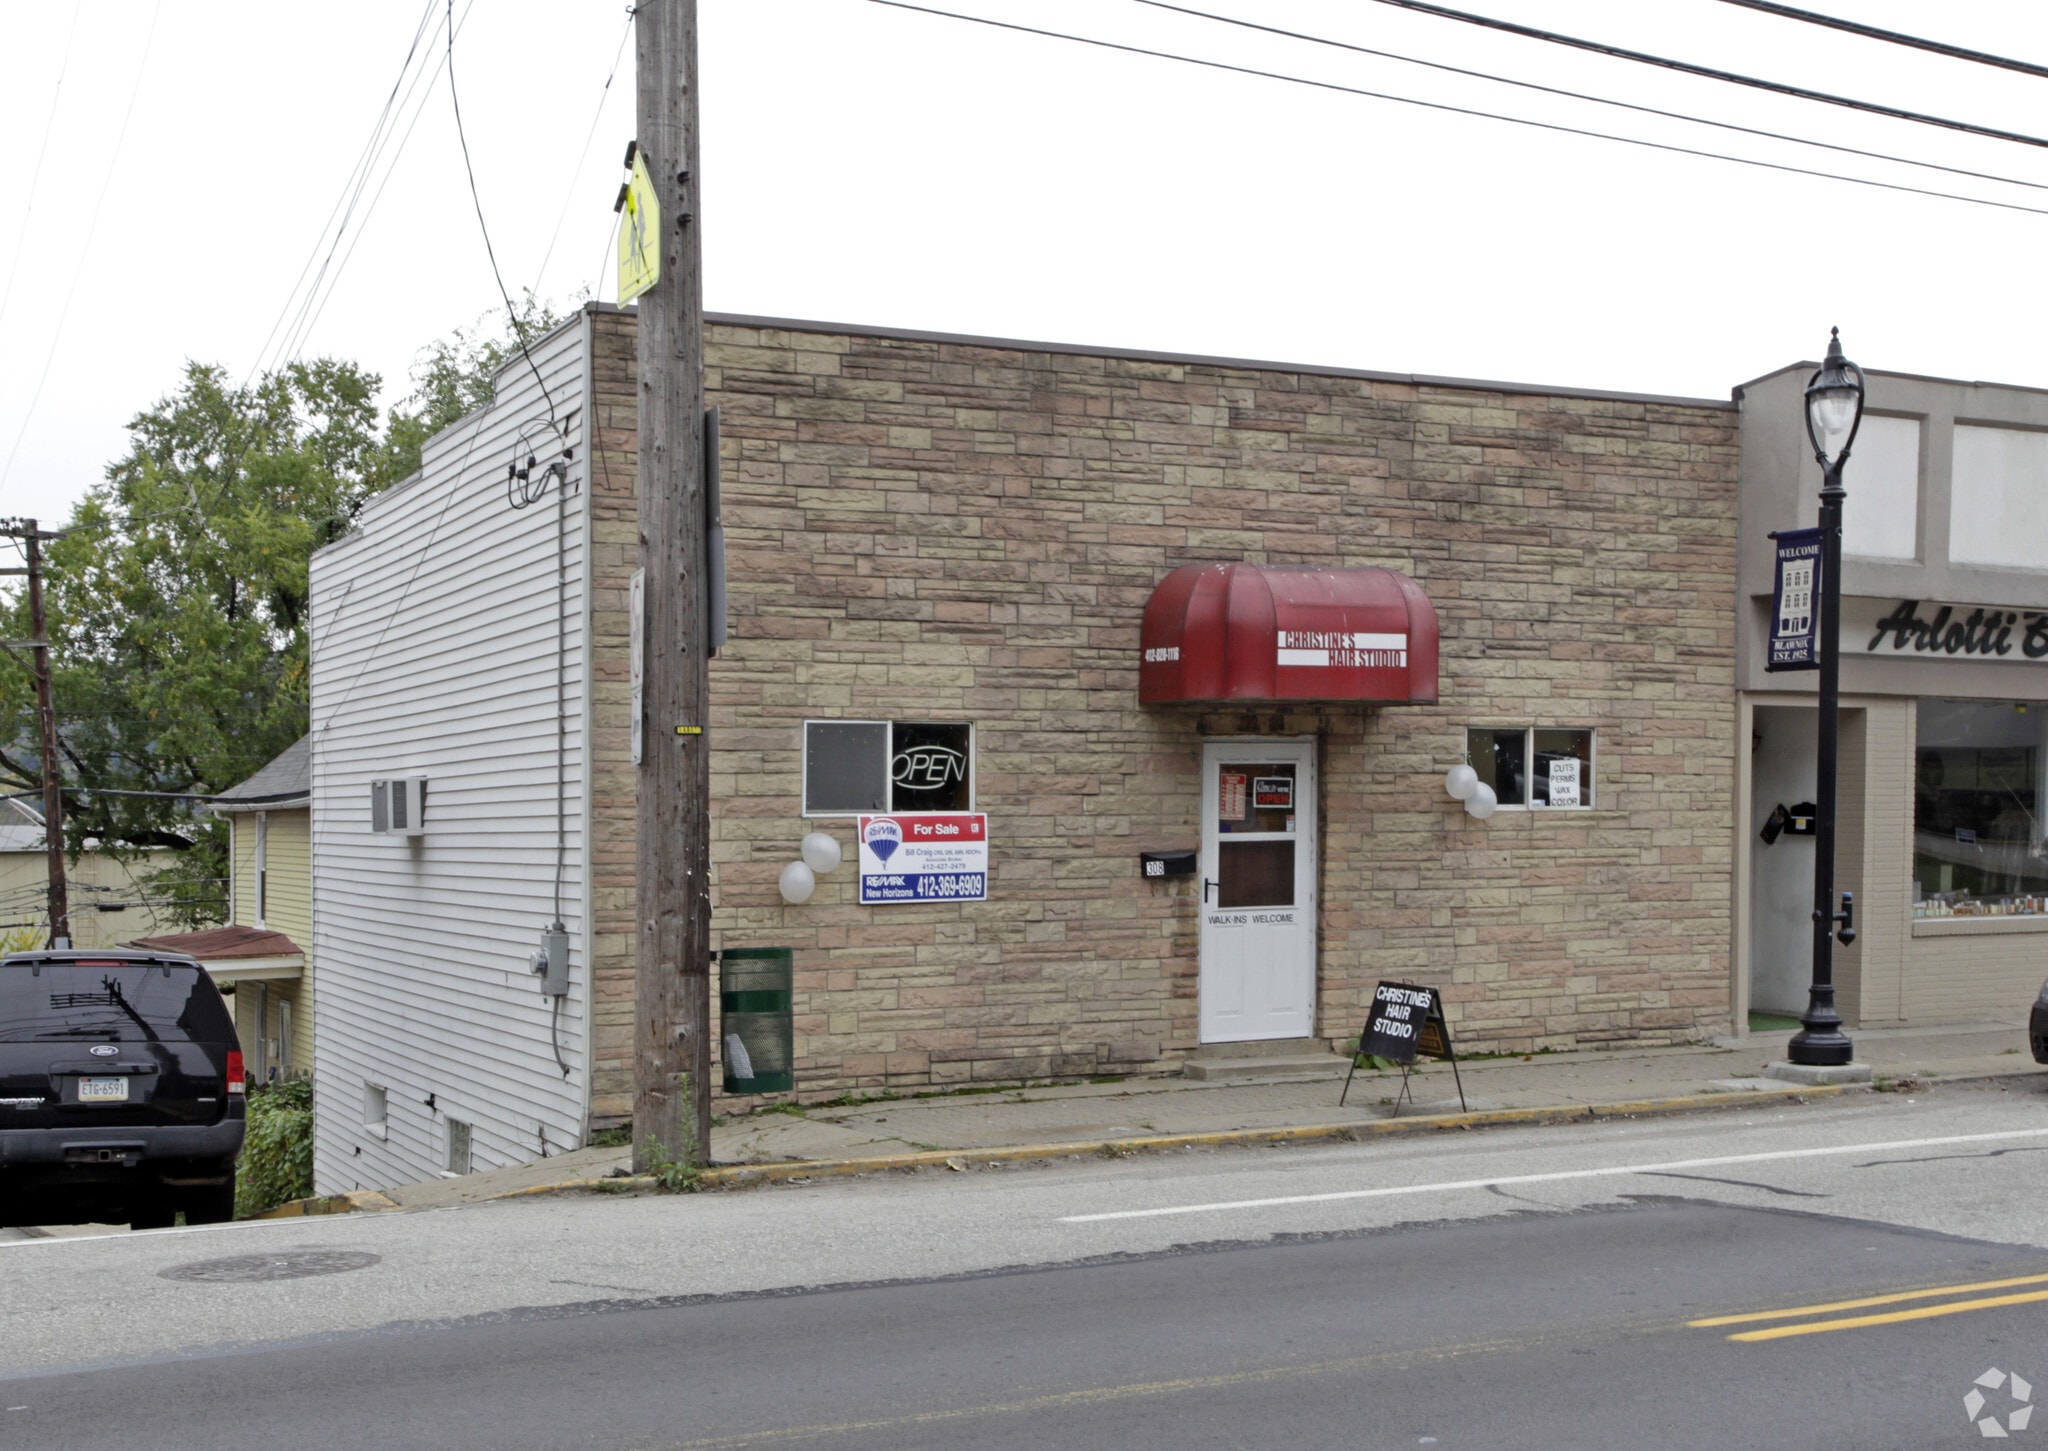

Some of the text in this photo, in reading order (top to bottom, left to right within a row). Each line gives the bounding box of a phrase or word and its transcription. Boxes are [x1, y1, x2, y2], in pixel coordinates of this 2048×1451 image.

[1779, 545, 1820, 558] WELCOME
[1868, 600, 2017, 656] Arlotti
[1329, 649, 1401, 667] HAIR STUDIO
[1774, 651, 1790, 660] EST.
[892, 754, 967, 781] OPEN
[1554, 764, 1575, 772] CUTS
[1555, 786, 1571, 794] WAX
[1258, 794, 1289, 804] OPEN
[1551, 797, 1577, 806] COLOR
[914, 824, 933, 835] For
[935, 823, 960, 834] Sale
[905, 848, 915, 856] Bill
[916, 848, 933, 857] Craig
[1147, 861, 1164, 875] 308
[866, 875, 982, 897] RE/MAX 412-369-6909
[866, 888, 914, 898] New Horizons
[1208, 914, 1294, 924] WALK-INS WELCOME
[1376, 986, 1432, 1008] CHRISTINE'S
[1385, 1004, 1411, 1020] HAIR
[1373, 1018, 1412, 1038] STUDIO
[82, 1083, 124, 1095] ETG-6591
